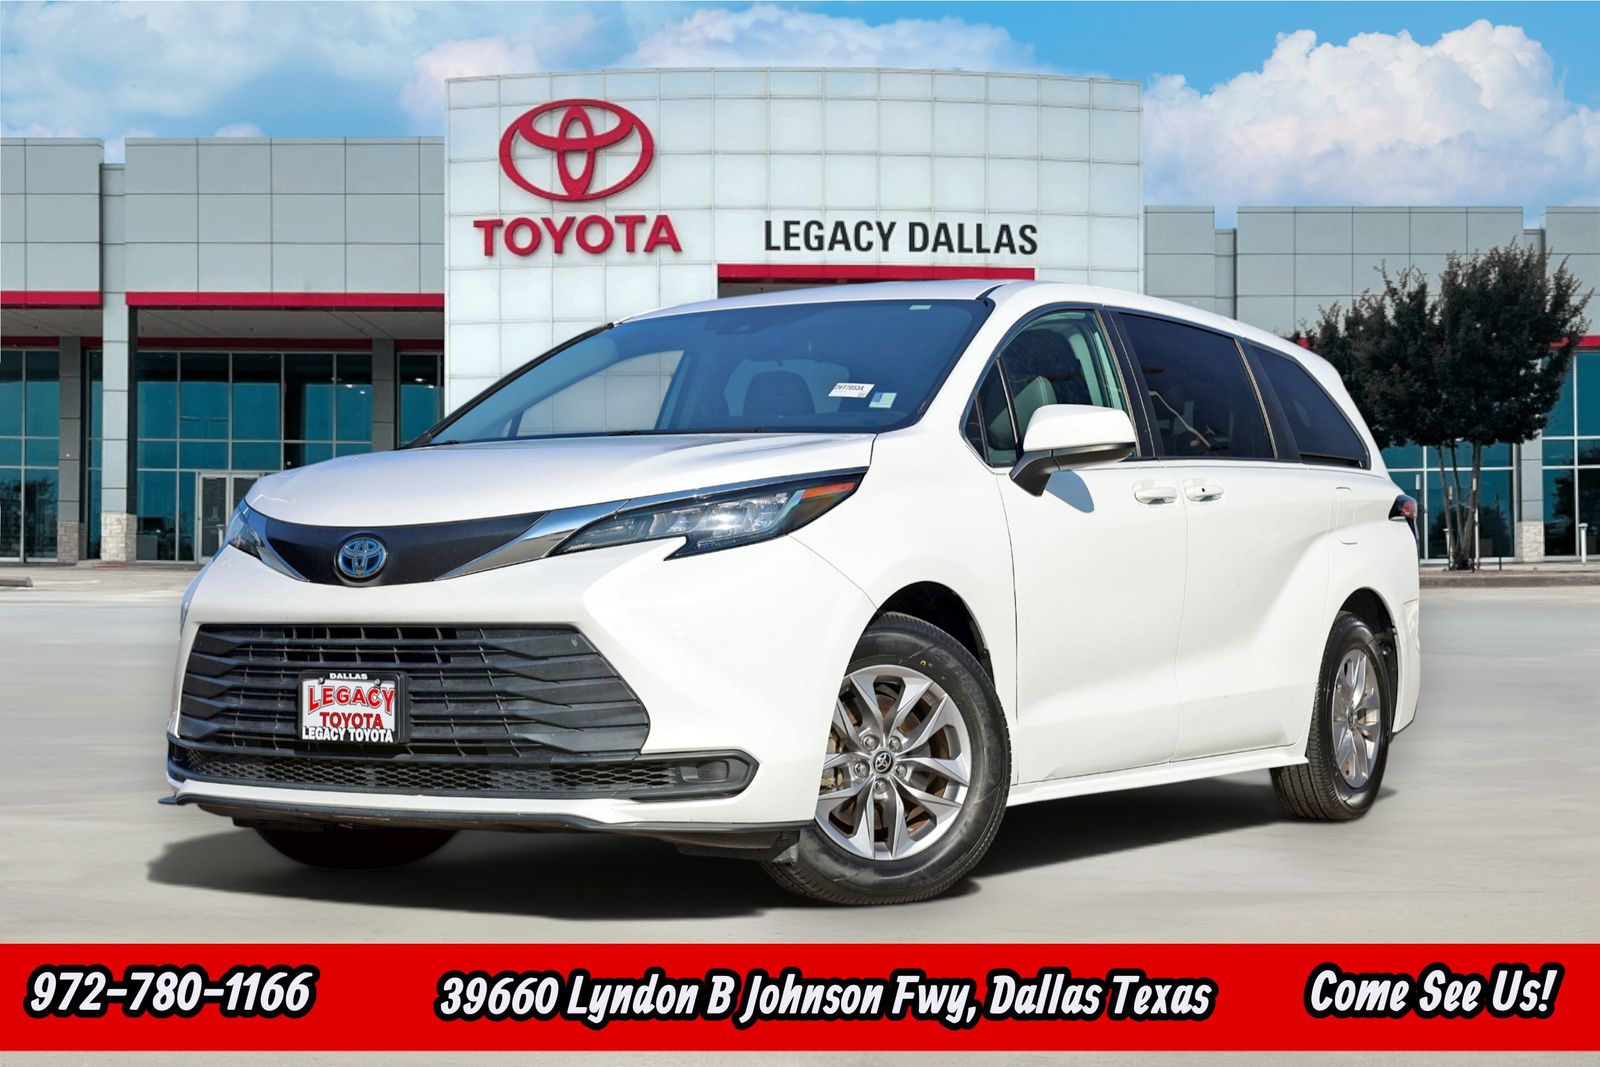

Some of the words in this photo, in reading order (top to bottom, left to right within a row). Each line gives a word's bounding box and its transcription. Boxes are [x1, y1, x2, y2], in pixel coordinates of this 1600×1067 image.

[474, 214, 682, 257] TOYOTA
[765, 220, 897, 252] LEGACY
[908, 221, 1038, 256] DALLAS
[329, 672, 368, 680] DALLAS
[308, 685, 395, 716] LEGACY
[319, 711, 384, 730] TOYOTA
[302, 726, 346, 741] LEGACY
[349, 727, 394, 743] TOYOTA
